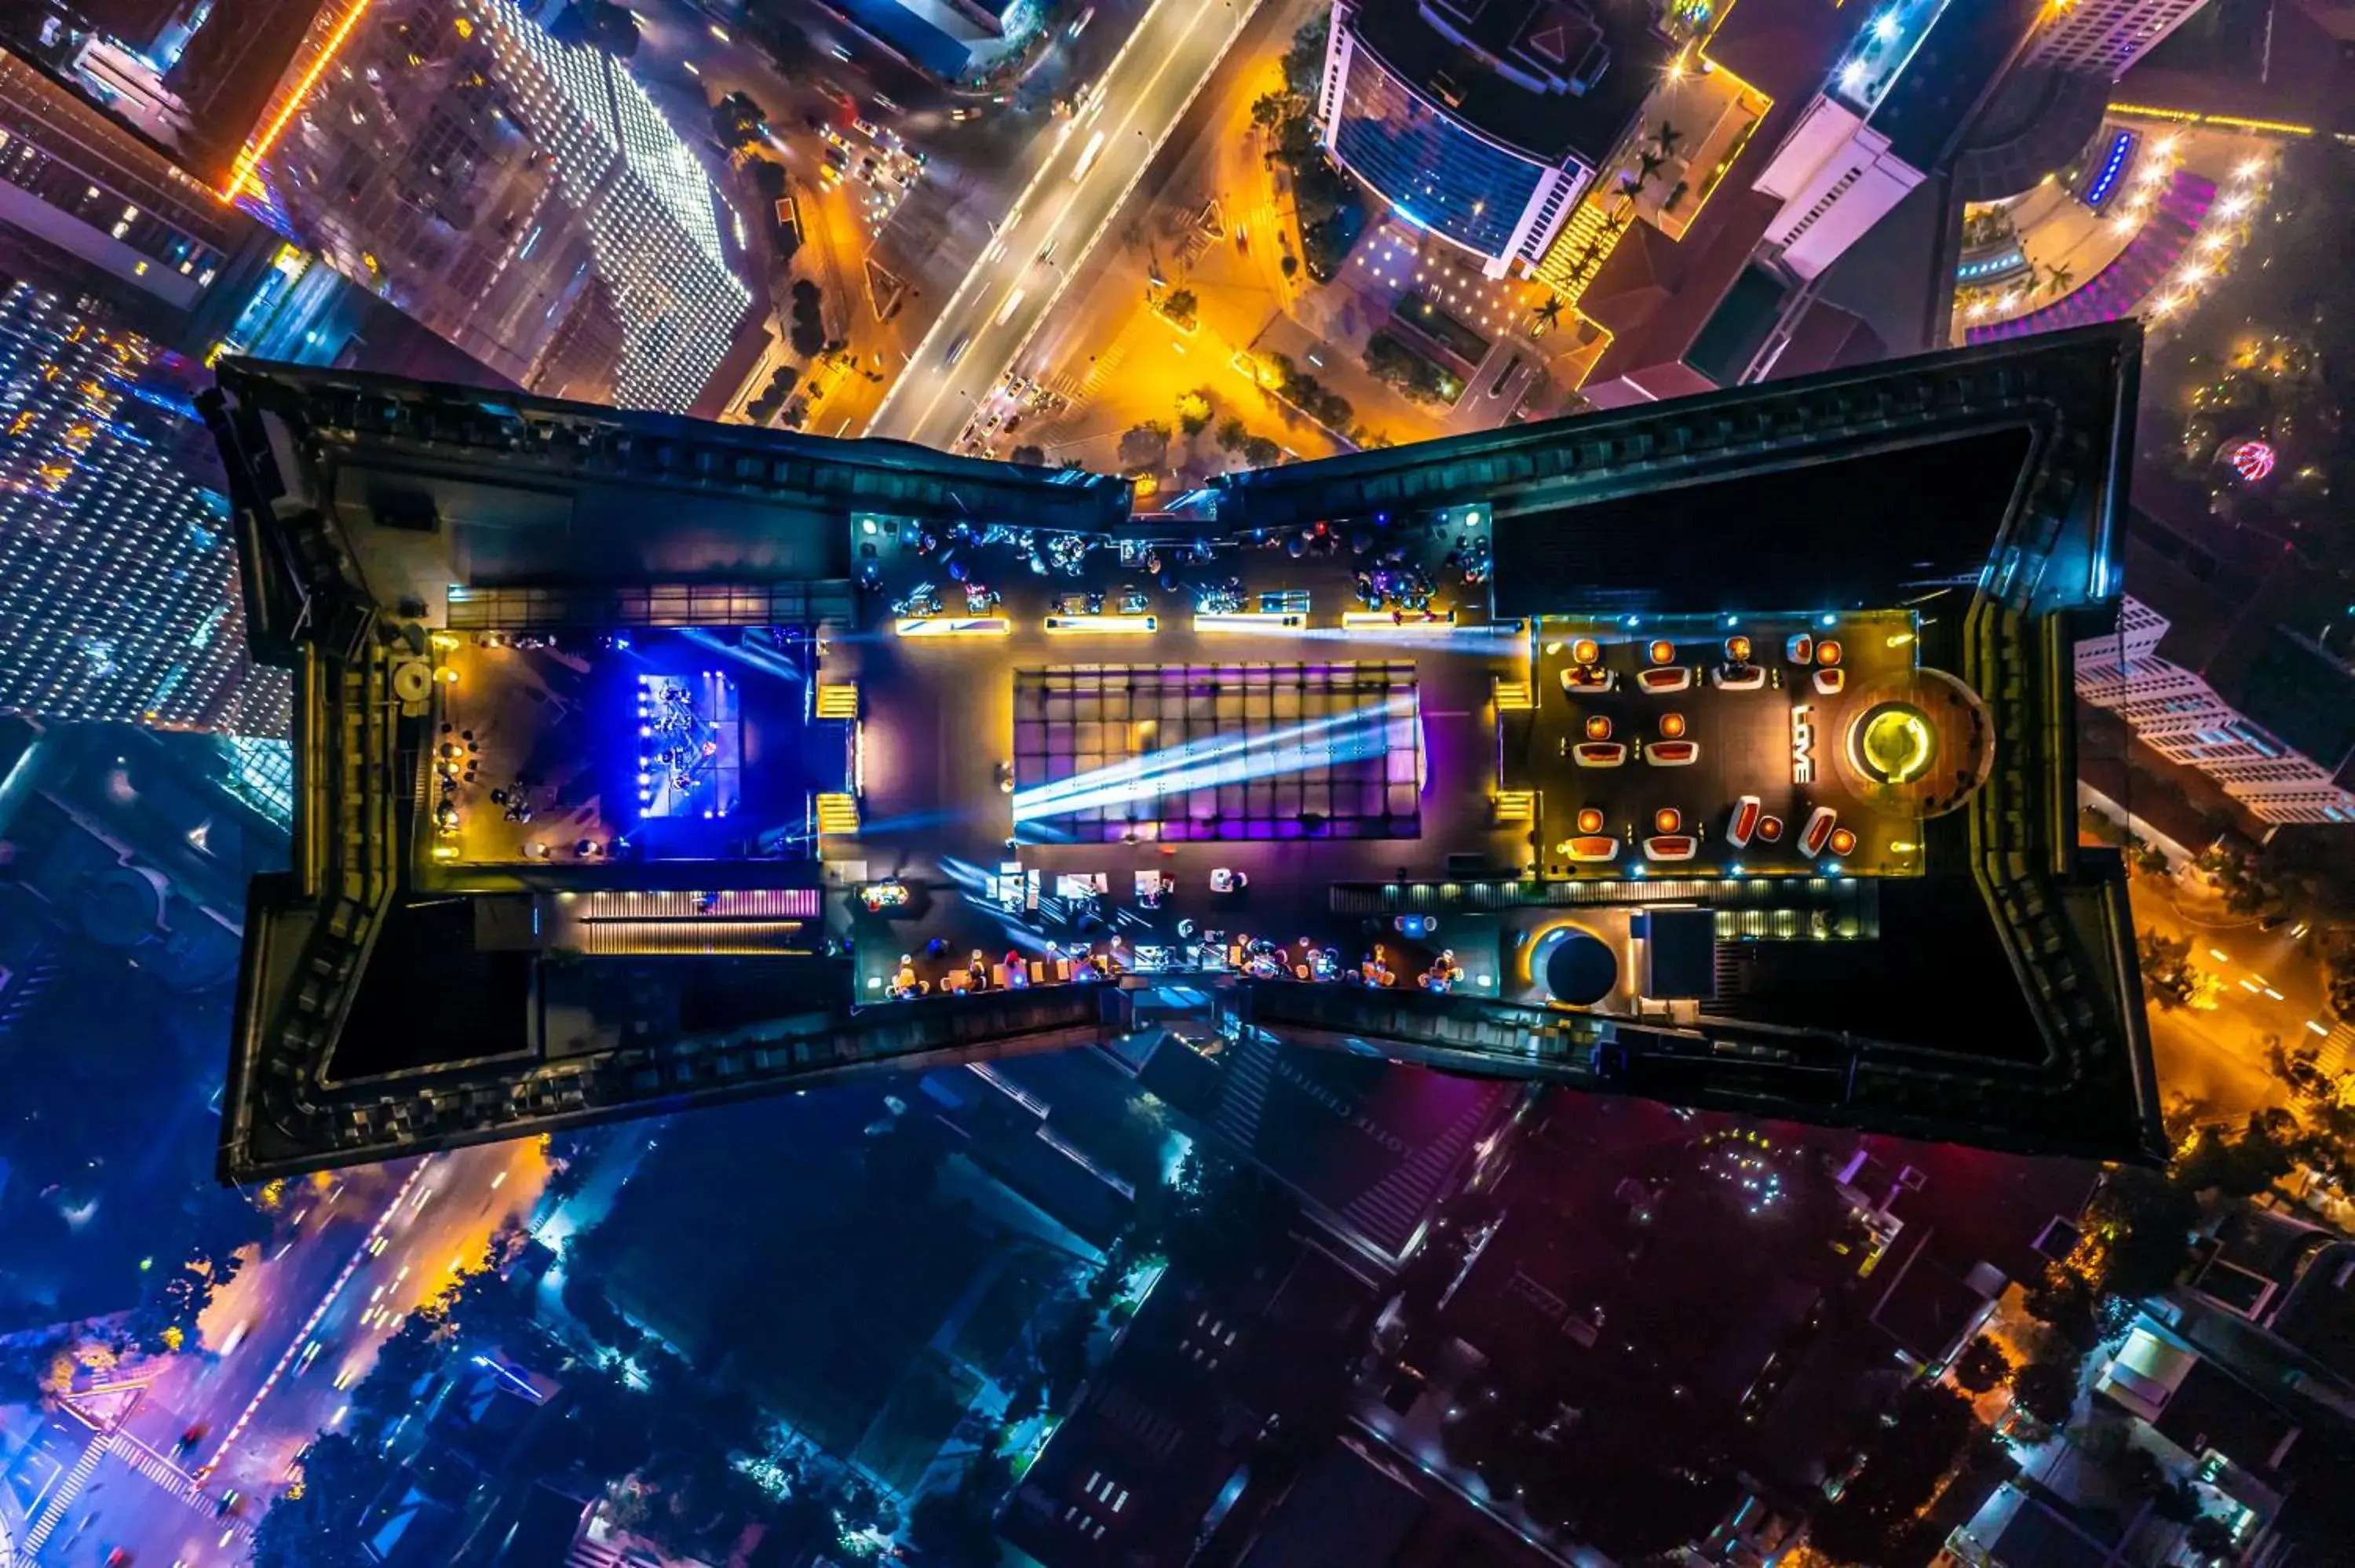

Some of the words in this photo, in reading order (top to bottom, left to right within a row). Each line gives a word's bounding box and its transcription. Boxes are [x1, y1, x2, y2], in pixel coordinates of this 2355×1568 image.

[1791, 706, 1809, 783] LOVE
[1276, 1060, 1351, 1117] CENTER
[1351, 1116, 1415, 1158] LOTTE
